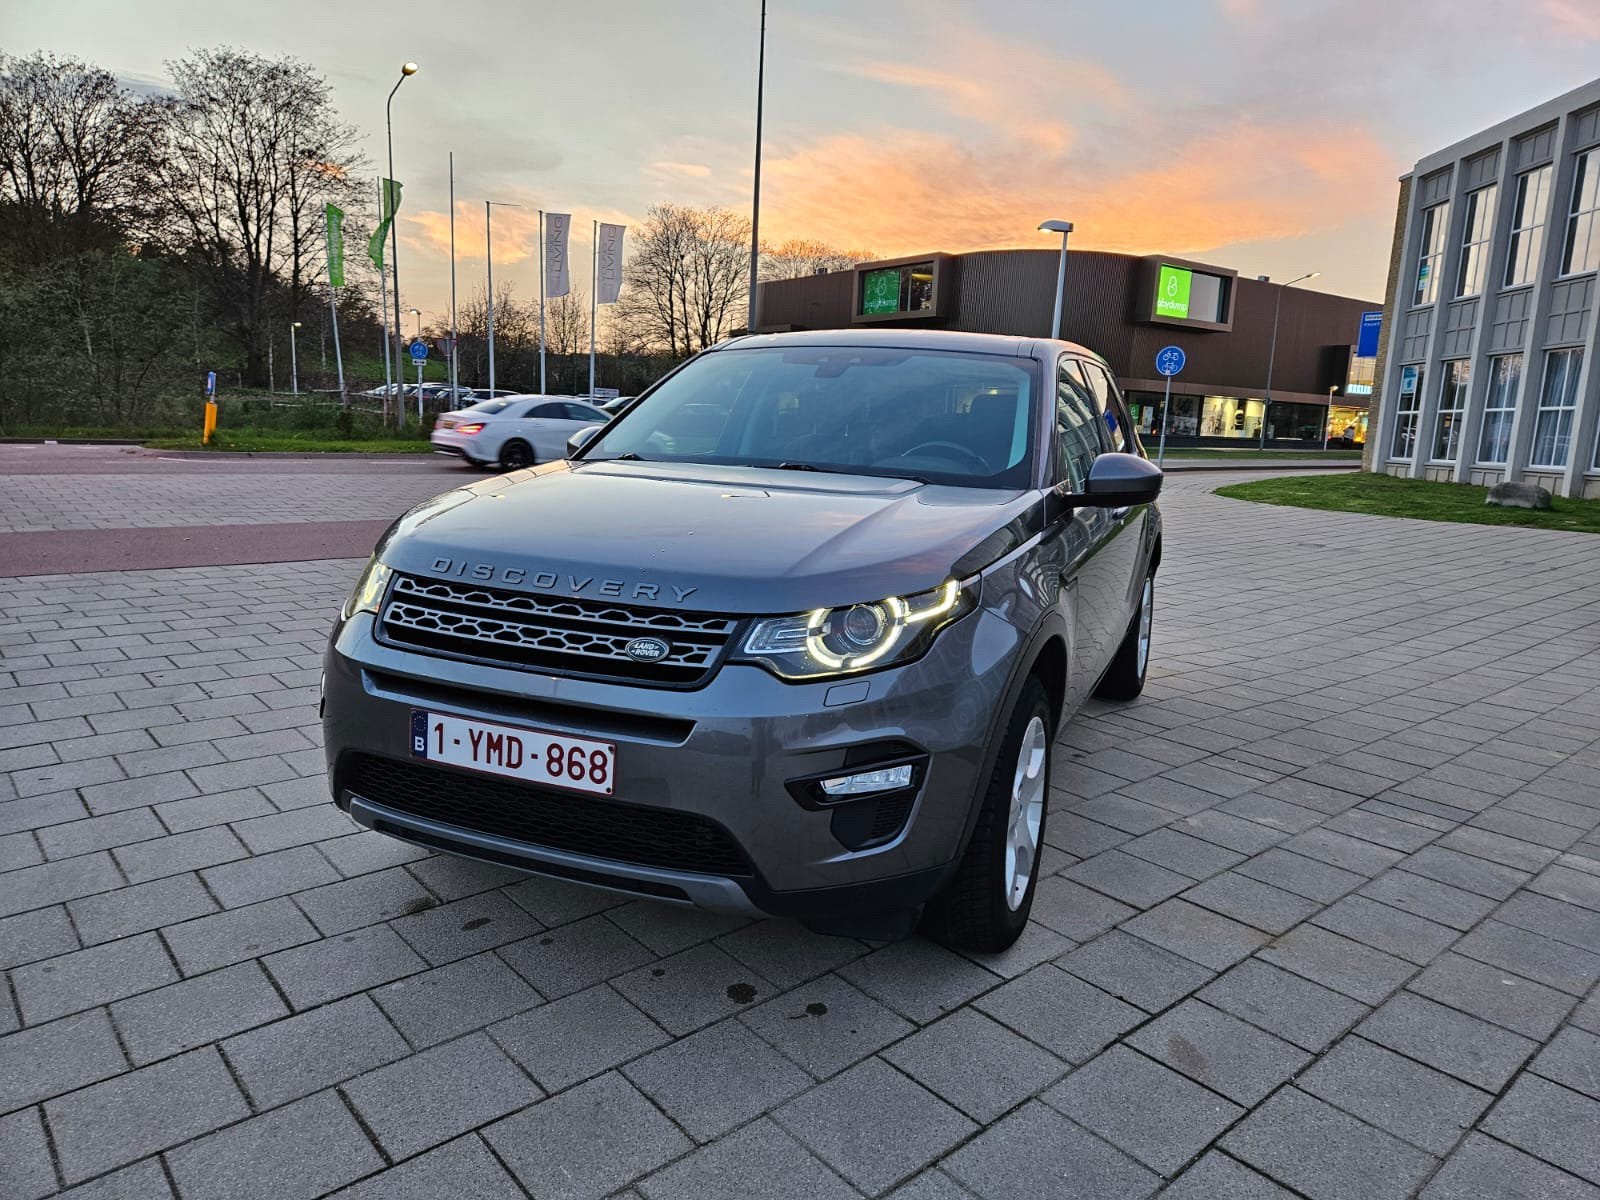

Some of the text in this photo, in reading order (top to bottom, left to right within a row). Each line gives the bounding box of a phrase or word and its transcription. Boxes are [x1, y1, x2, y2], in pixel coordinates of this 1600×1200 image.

[552, 216, 562, 272] LIVING
[606, 226, 617, 280] LIVING
[430, 557, 697, 602] DISCOVERY
[635, 649, 659, 657] ROVER
[414, 736, 425, 752] B
[434, 722, 608, 784] 1-YMD-868
